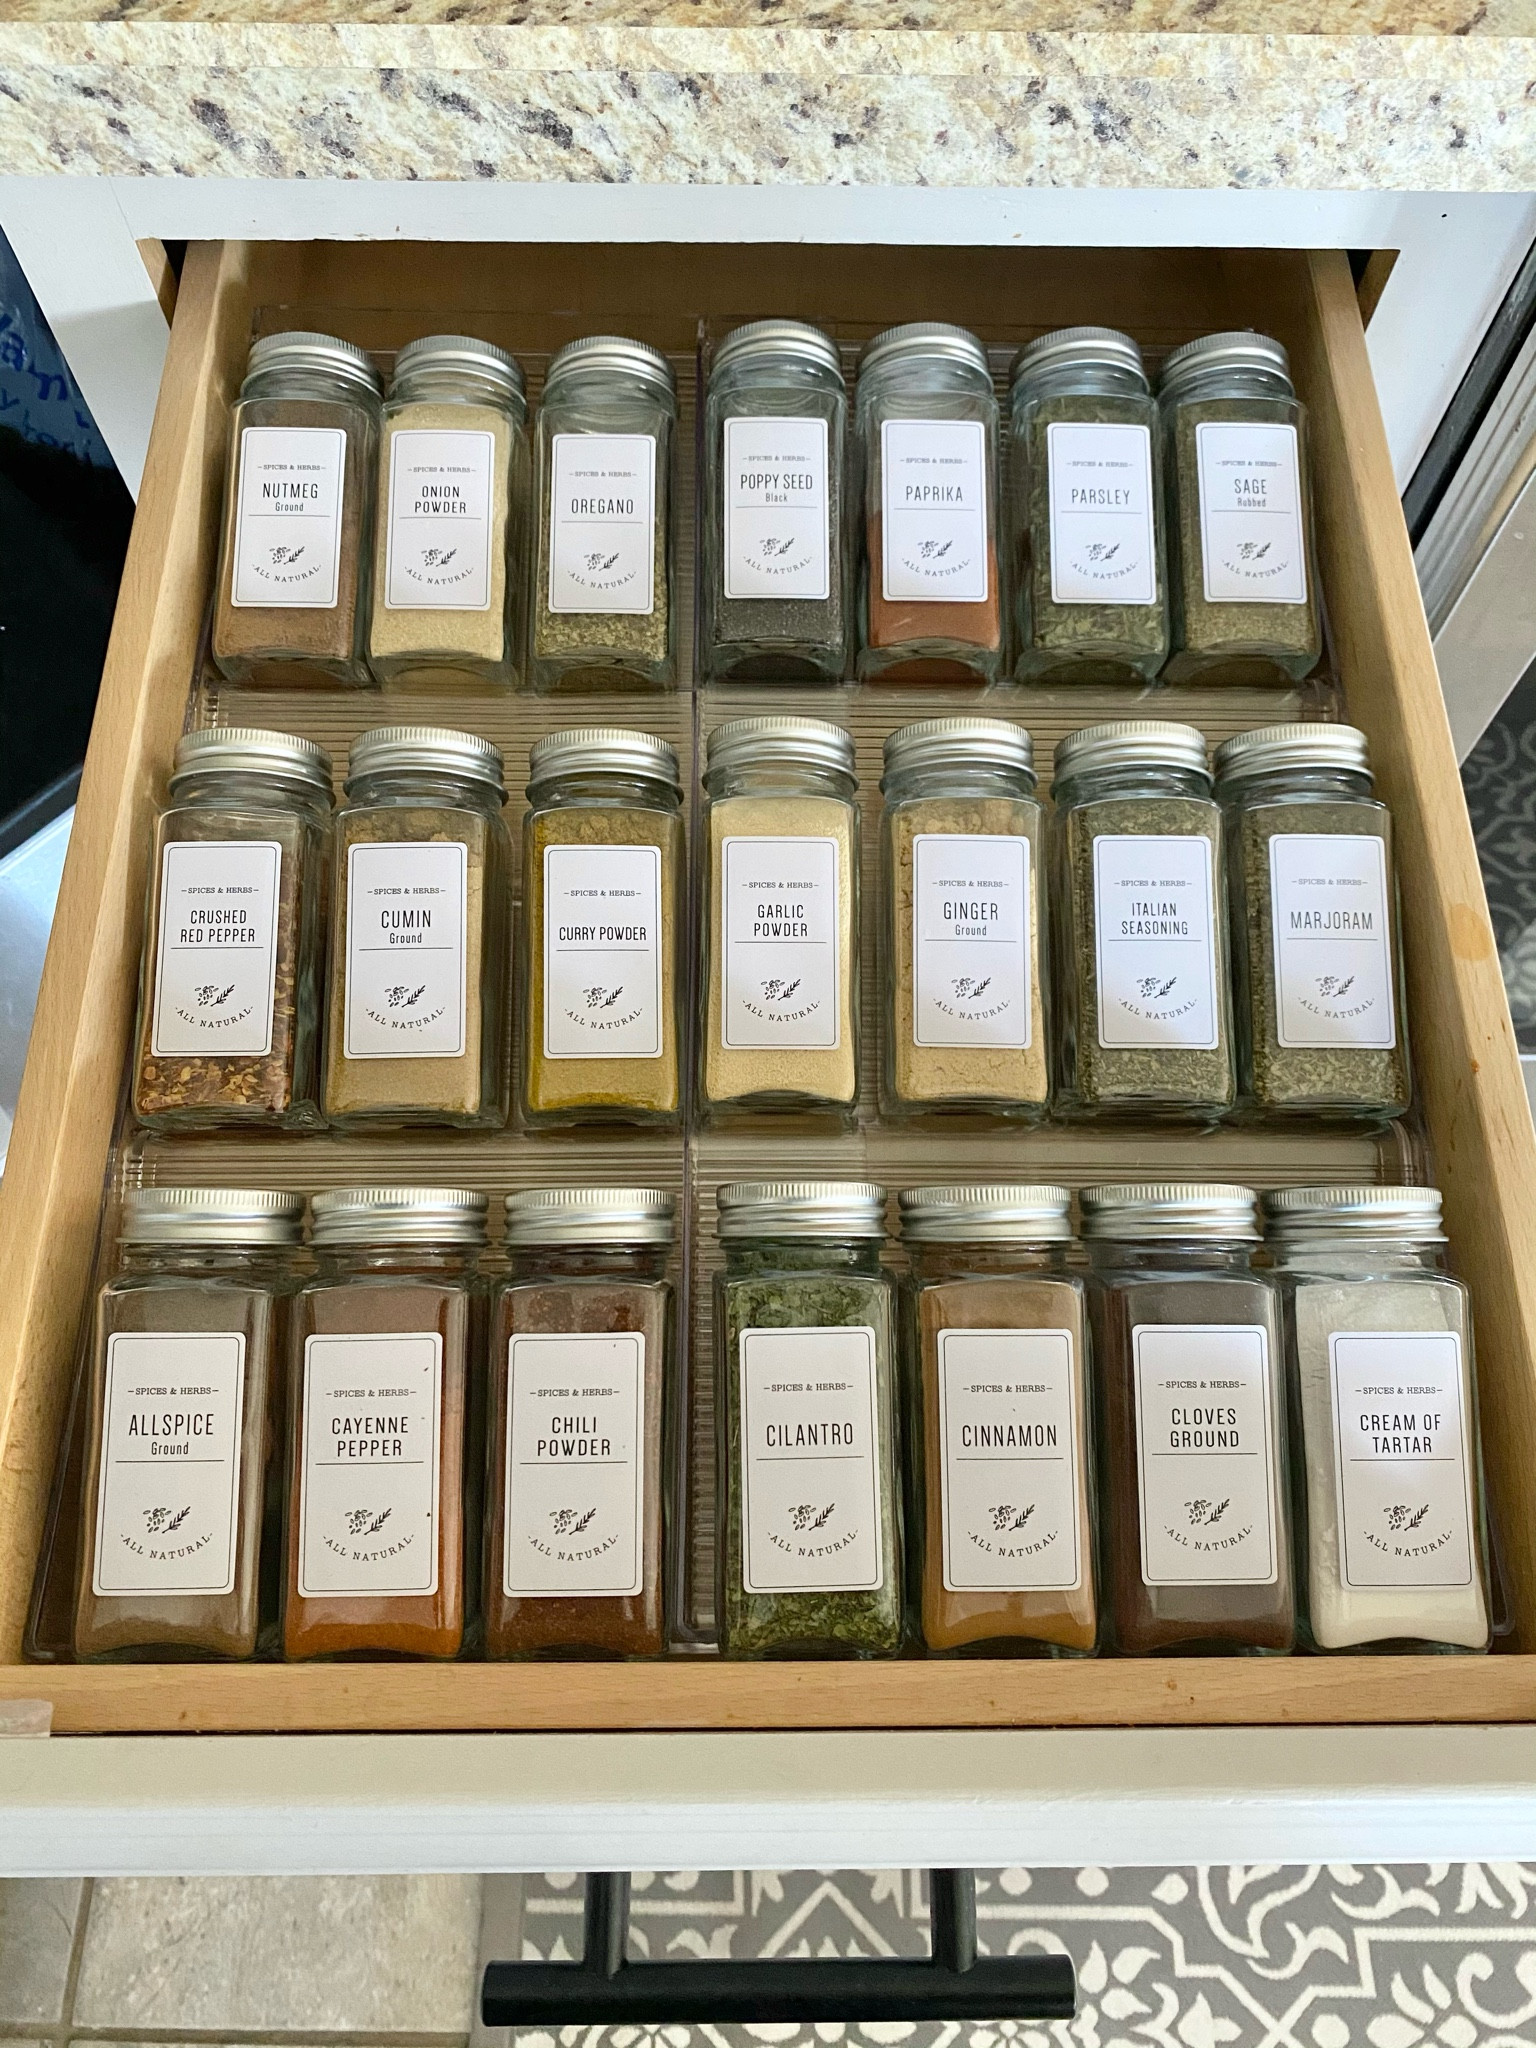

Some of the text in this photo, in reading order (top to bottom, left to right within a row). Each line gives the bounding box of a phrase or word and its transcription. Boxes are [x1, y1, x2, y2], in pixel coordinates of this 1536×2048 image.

[740, 473, 813, 490] POPPY SEED
[1234, 478, 1267, 495] SAGE
[262, 482, 318, 499] NUTMEG
[422, 485, 460, 498] ONION
[765, 492, 788, 503] Black
[906, 485, 963, 502] PAPRIKA
[1071, 488, 1130, 505] PARSLEY
[275, 501, 304, 512] Ground
[414, 501, 466, 514] POWDER
[571, 498, 634, 515] OREGANO
[1237, 497, 1266, 507] Rubbed
[403, 887, 410, 895] &
[968, 880, 975, 888] &
[190, 909, 247, 925] CRUSHED
[757, 904, 804, 919] GARLIC
[943, 901, 998, 921] GINGER
[1132, 902, 1177, 917] ITALIAN
[381, 910, 431, 929] CUMIN
[1290, 911, 1373, 930] MARJORAM
[559, 926, 647, 941] CURRY POWDER
[754, 922, 808, 937] POWDER
[955, 924, 987, 936] Ground
[1121, 920, 1188, 935] SEASONING
[180, 928, 255, 943] RED PEPPER
[389, 932, 422, 944] Ground
[169, 1387, 177, 1395] &
[367, 1389, 375, 1397] &
[572, 1389, 579, 1397] &
[806, 1383, 813, 1391] &
[1005, 1385, 1012, 1393] &
[1397, 1386, 1404, 1395] &
[1171, 1408, 1236, 1425] CLOVES
[1360, 1414, 1441, 1431] CREAM OF
[128, 1413, 214, 1436] ALLSPICE
[331, 1416, 409, 1436] CAYENNE
[551, 1416, 597, 1434] CHILI
[766, 1422, 853, 1447] CILANTRO
[961, 1425, 1058, 1448] CINNAMON
[1170, 1430, 1239, 1448] GROUND
[151, 1441, 189, 1456] Ground
[337, 1439, 402, 1458] PEPPER
[537, 1439, 611, 1457] POWDER
[1372, 1436, 1432, 1454] TARTAR
